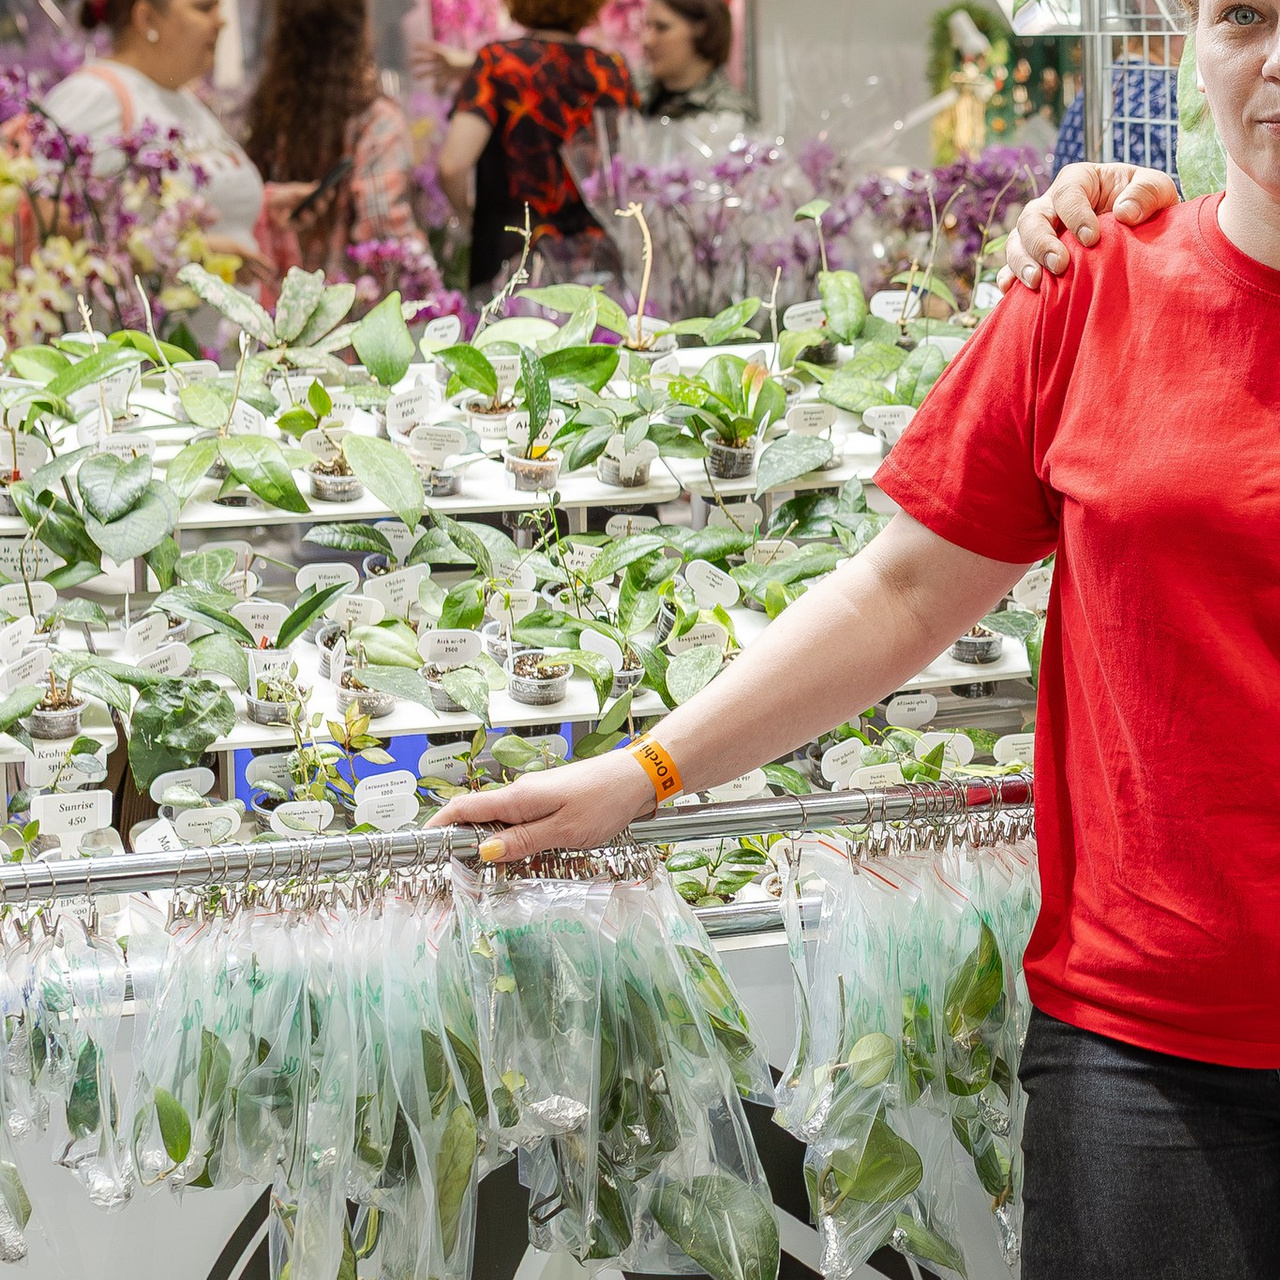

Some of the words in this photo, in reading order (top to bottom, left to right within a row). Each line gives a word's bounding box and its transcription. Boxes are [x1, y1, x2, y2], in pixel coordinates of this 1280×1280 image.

[639, 744, 669, 777] Orchi
[58, 801, 95, 813] Sunrise
[67, 816, 87, 826] 450
[60, 896, 91, 908] EPC-5
